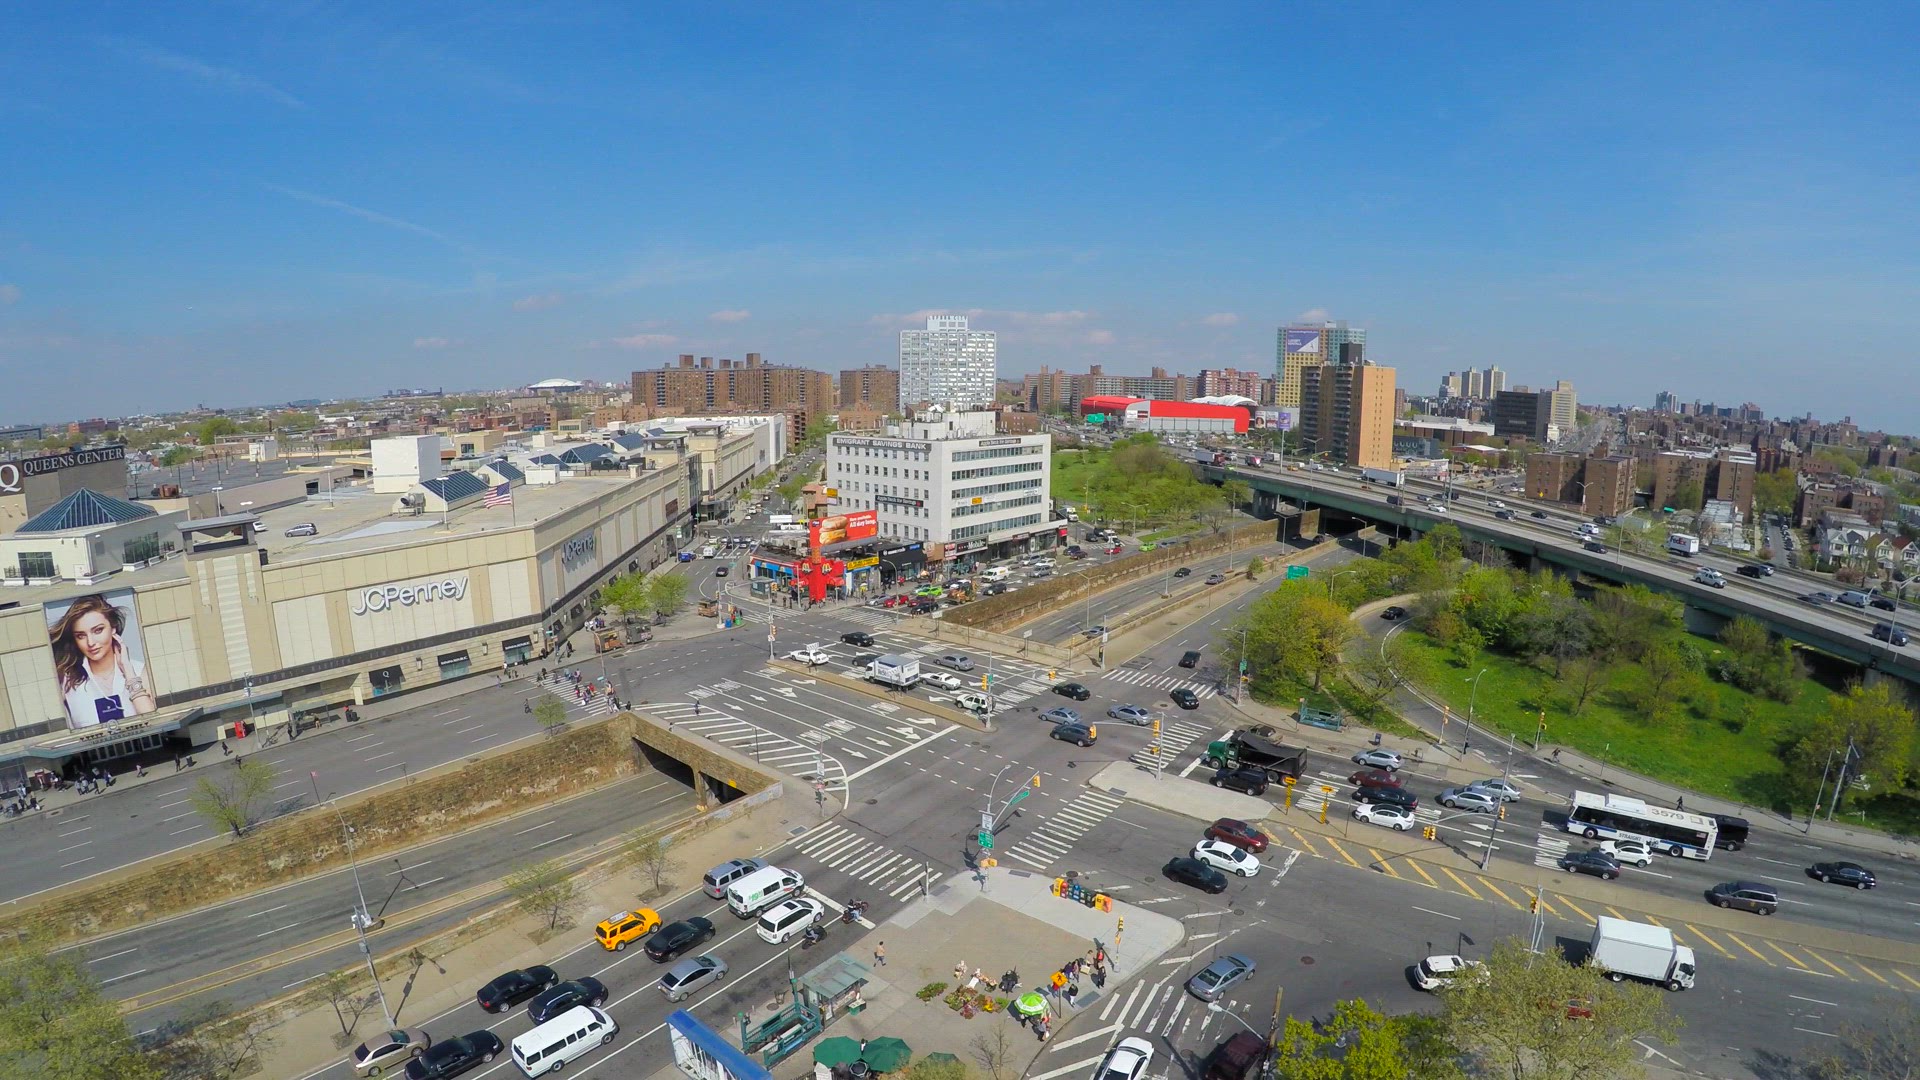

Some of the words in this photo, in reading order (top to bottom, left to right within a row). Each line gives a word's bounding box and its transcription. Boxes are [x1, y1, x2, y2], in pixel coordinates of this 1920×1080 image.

[836, 438, 870, 446] EMIGRANT
[872, 440, 903, 448] SAVINGS
[905, 442, 927, 450] BANK
[24, 455, 75, 475] QUEENS
[77, 448, 123, 465] CENTER
[0, 464, 21, 492] Q
[352, 577, 468, 615] JCPenney
[1652, 808, 1684, 820] 3579
[1618, 832, 1642, 841] STRAIGHT
